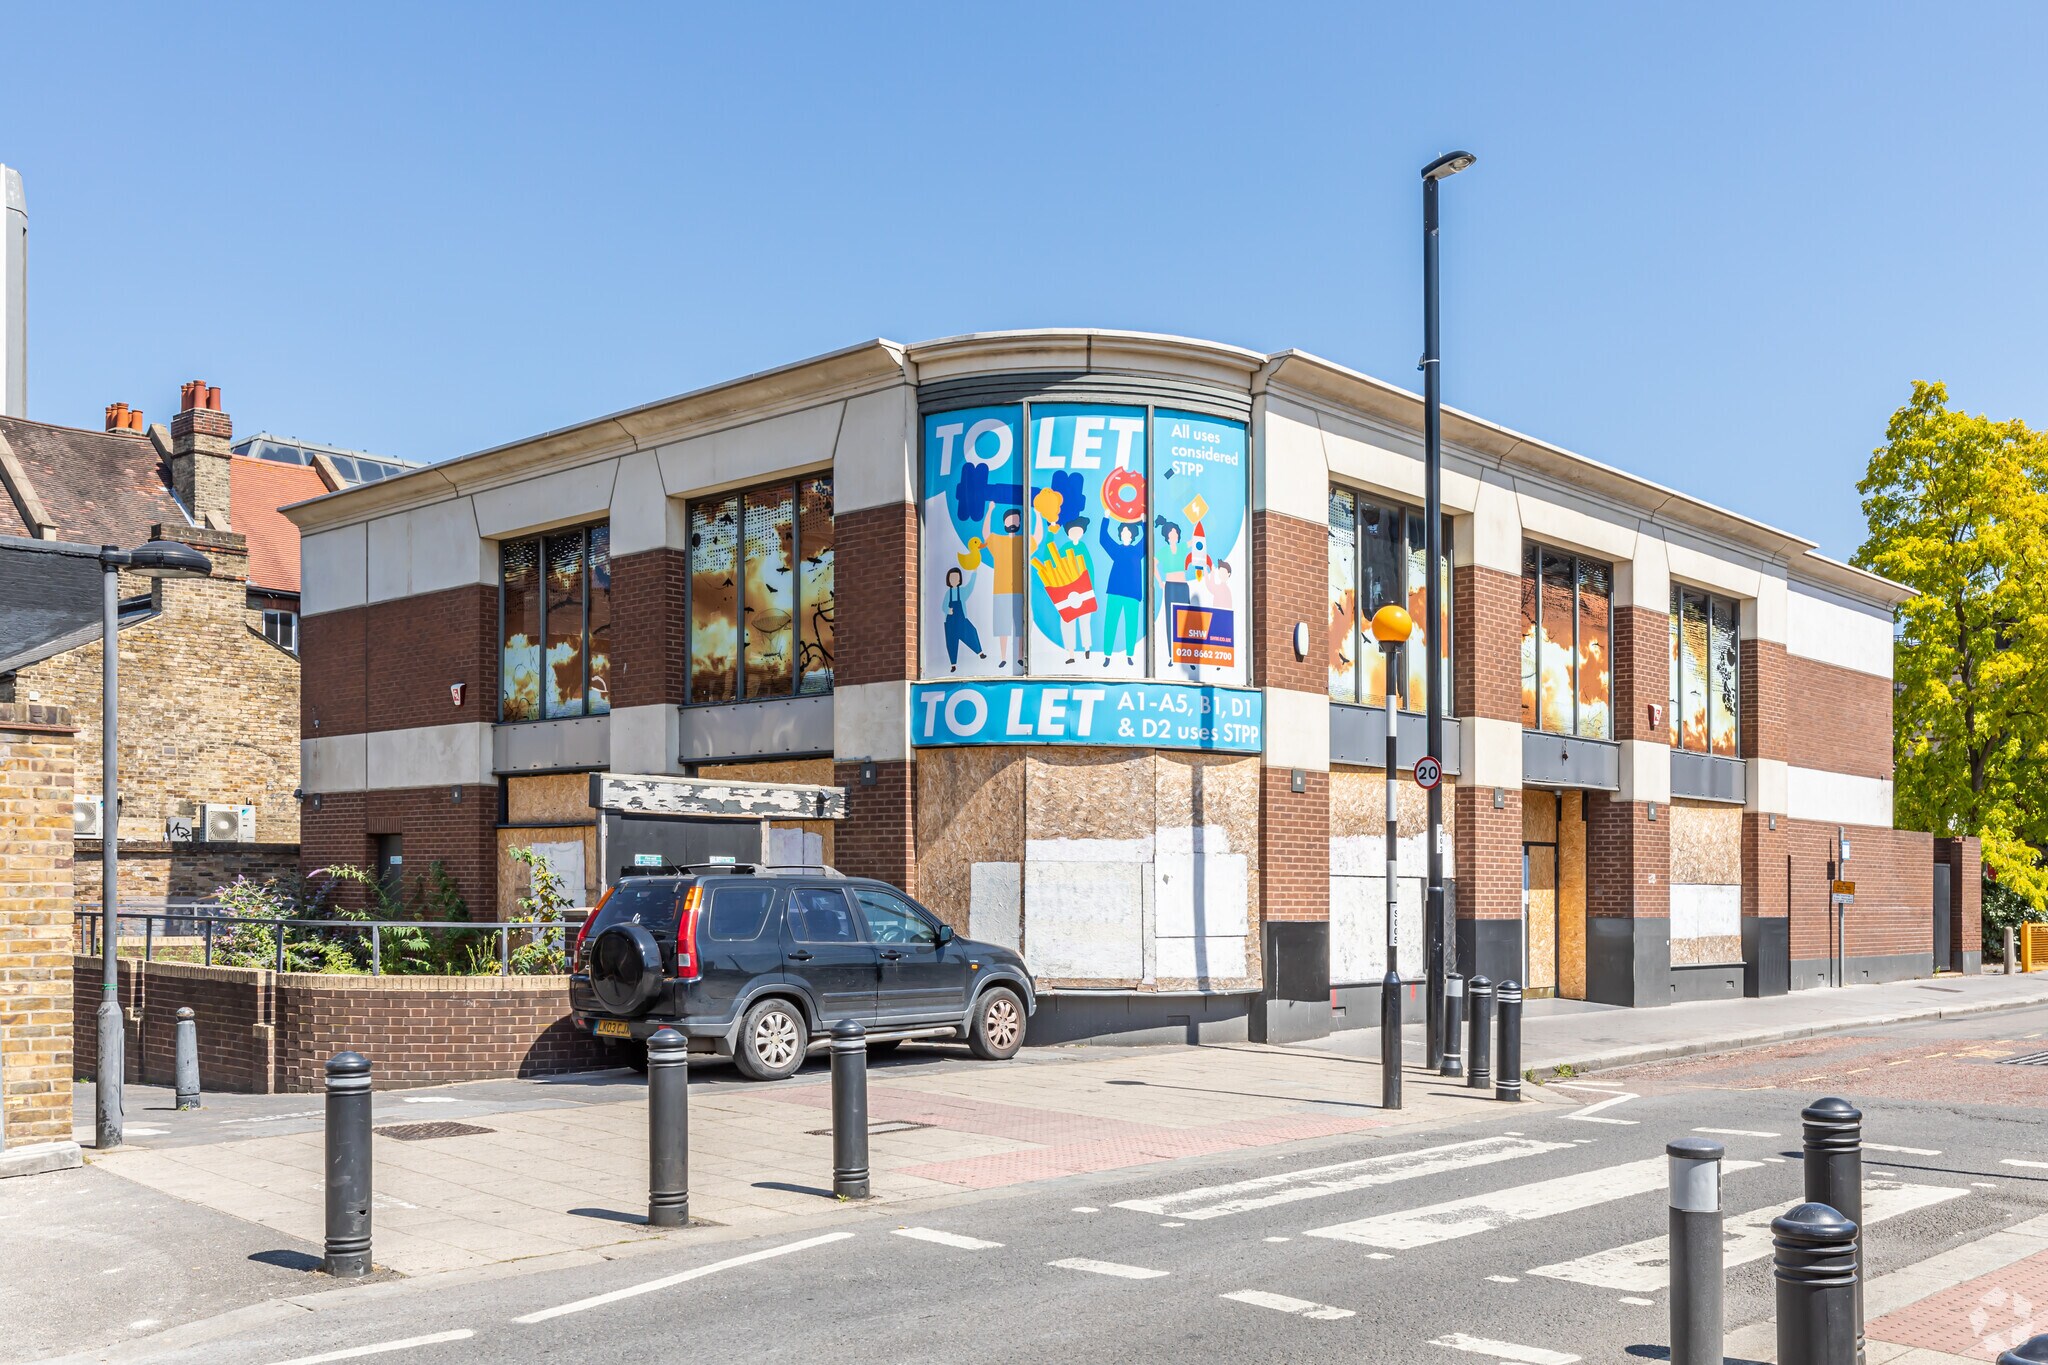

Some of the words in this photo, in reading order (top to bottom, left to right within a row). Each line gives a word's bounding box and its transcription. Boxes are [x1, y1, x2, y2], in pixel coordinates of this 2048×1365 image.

[1171, 424, 1190, 439] All
[1193, 430, 1221, 444] uses
[935, 418, 1014, 477] TO
[1035, 416, 1145, 470] LET
[1171, 443, 1239, 467] considered
[1172, 460, 1204, 477] STPP
[1188, 629, 1207, 638] SHW
[1176, 648, 1192, 657] 020
[1193, 650, 1213, 659] 8662
[1214, 651, 1232, 660] 2700
[920, 688, 988, 737] TO
[1005, 688, 1105, 737] LET
[1117, 691, 1193, 718] A1-A5,
[1200, 695, 1226, 719] B1,
[1231, 697, 1251, 718] D1
[1117, 718, 1135, 738] &
[1142, 719, 1171, 739] D2
[1177, 725, 1219, 741] uses
[1223, 723, 1259, 745] STPP
[1418, 766, 1438, 780] 20
